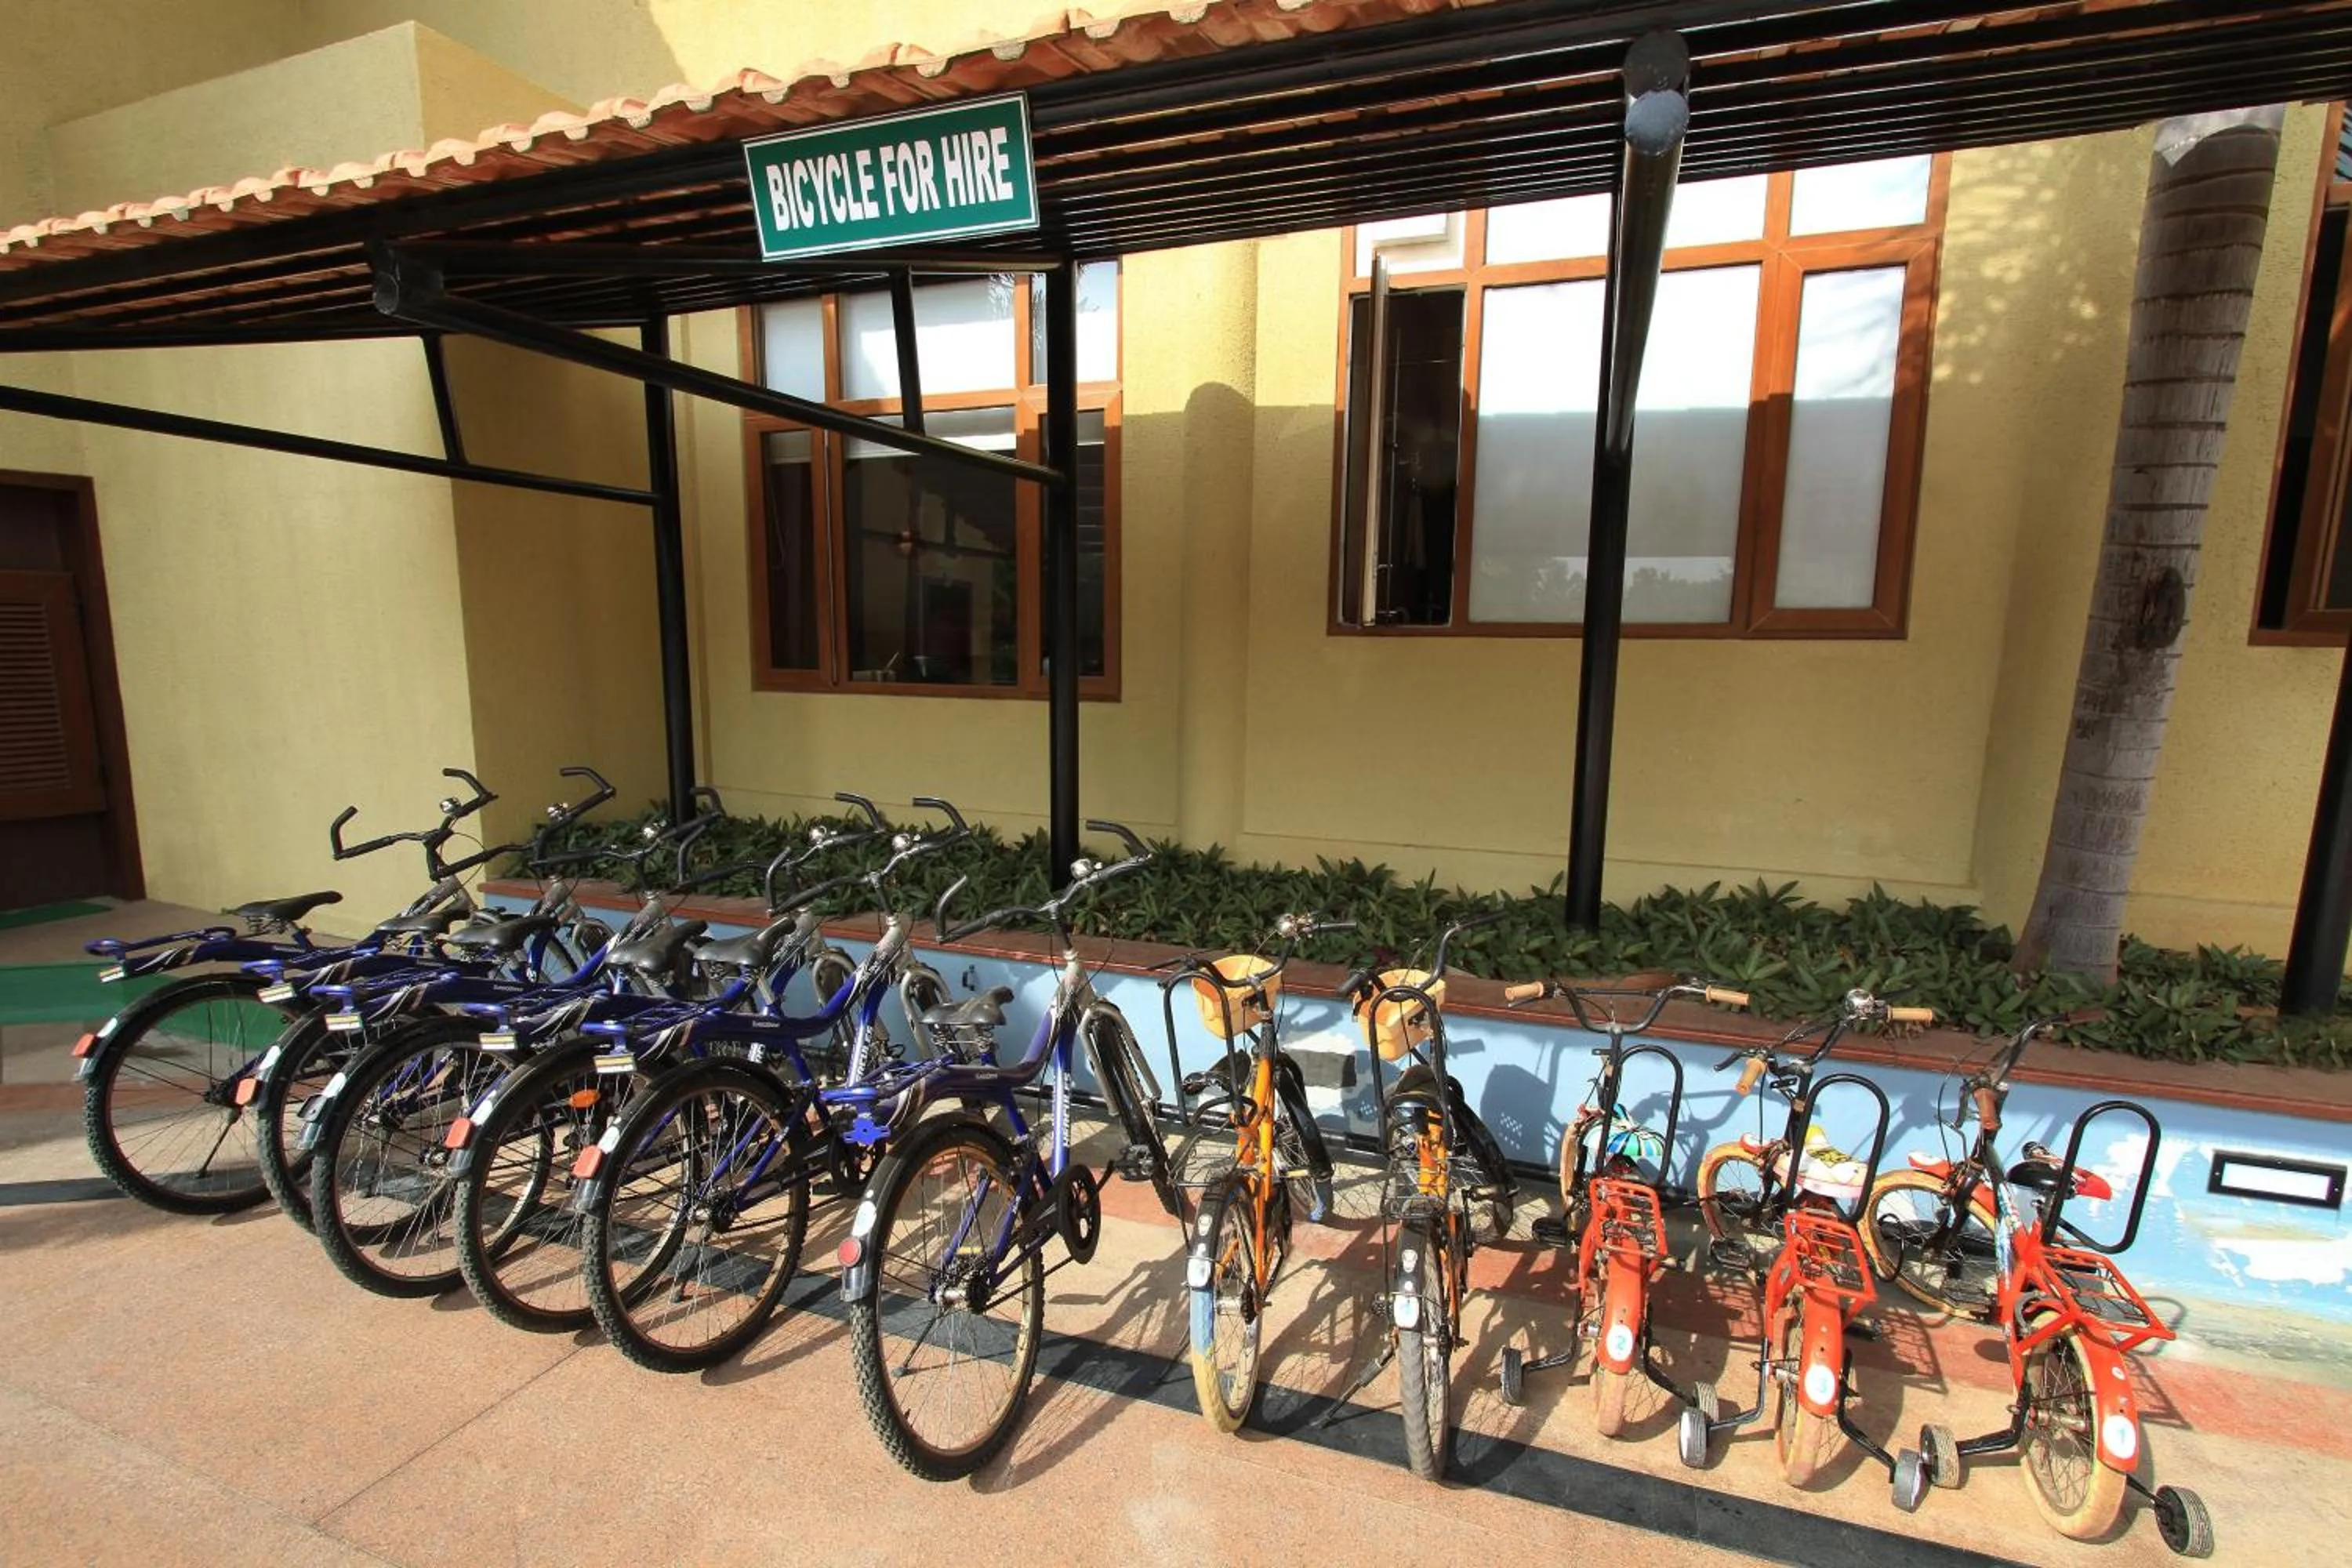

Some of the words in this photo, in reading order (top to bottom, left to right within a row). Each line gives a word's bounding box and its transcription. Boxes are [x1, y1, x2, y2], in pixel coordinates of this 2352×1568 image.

[765, 149, 880, 232] BICYCLE
[879, 140, 941, 216] FOR
[941, 126, 1014, 208] HIRE
